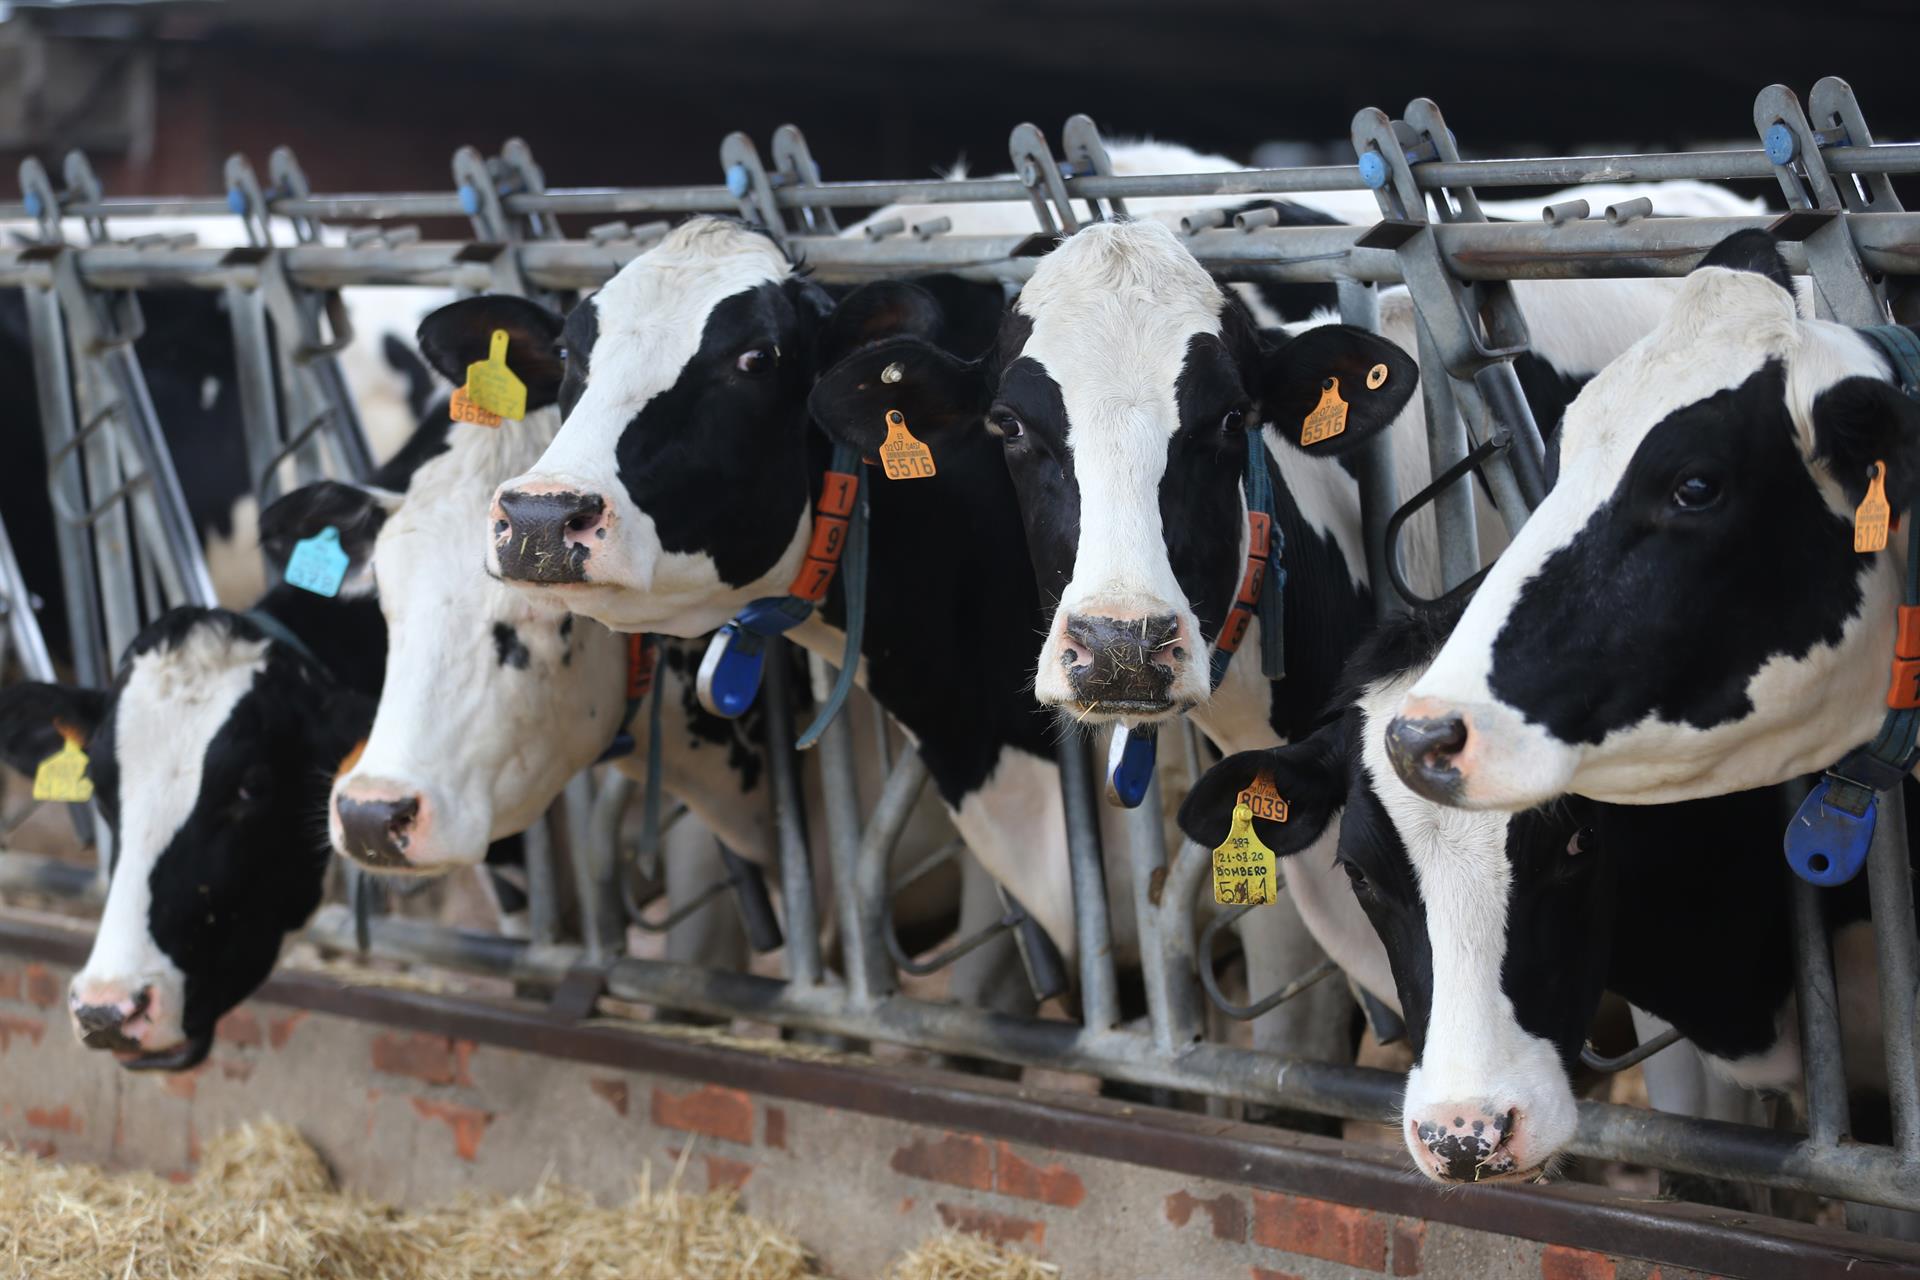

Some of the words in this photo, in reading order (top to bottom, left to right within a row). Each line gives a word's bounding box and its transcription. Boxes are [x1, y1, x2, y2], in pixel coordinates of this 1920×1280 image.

[1303, 415, 1343, 444] 5516
[886, 456, 934, 478] 5516
[1856, 524, 1885, 550] 5128
[1242, 792, 1285, 820] 8039
[1216, 866, 1267, 877] BOMBERO
